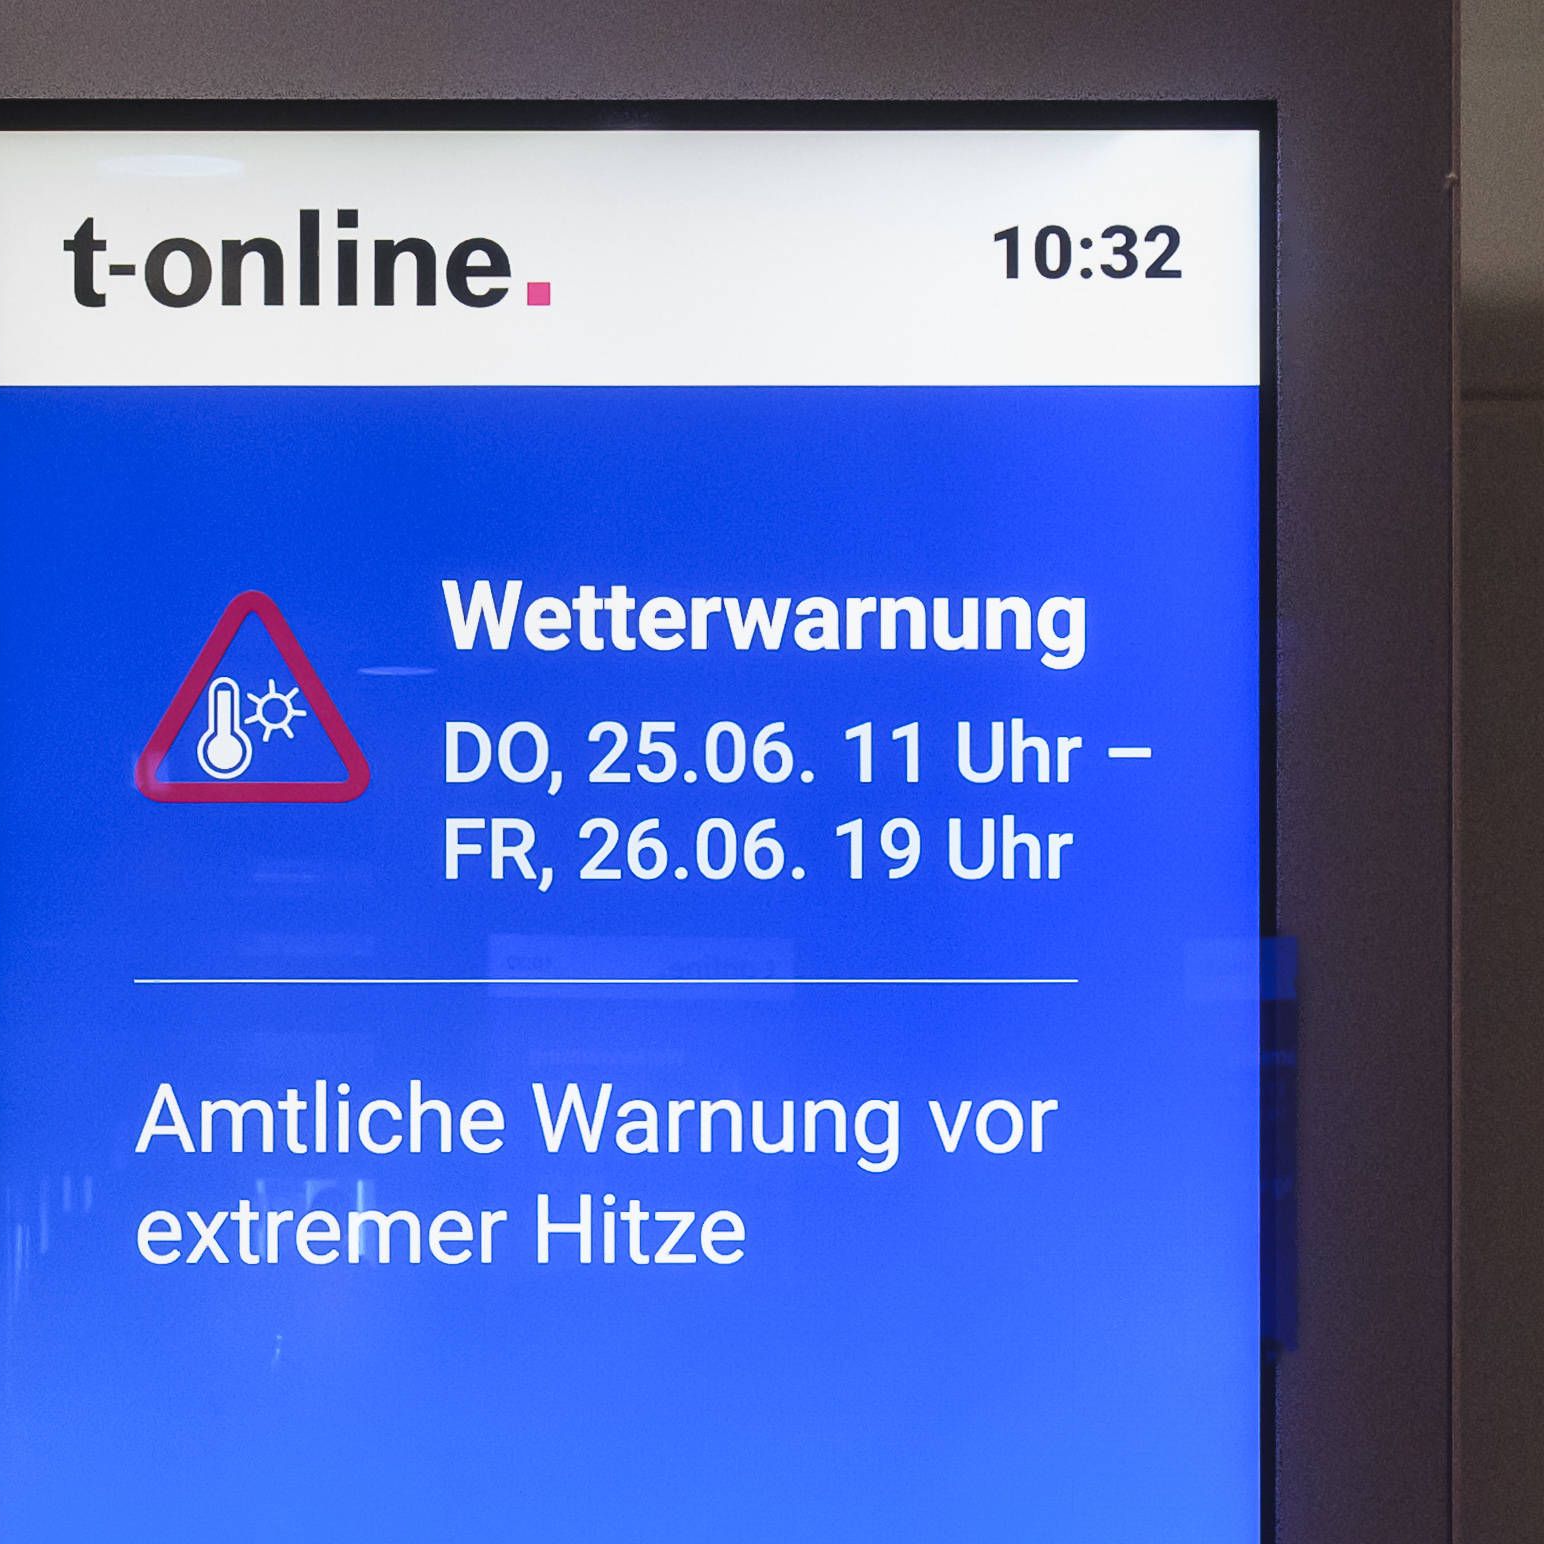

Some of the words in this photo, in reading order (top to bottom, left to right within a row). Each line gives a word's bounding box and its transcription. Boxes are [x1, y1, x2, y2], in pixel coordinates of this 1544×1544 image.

[63, 208, 551, 309] t-online.
[993, 224, 1182, 280] 10:32
[441, 579, 1086, 670] Wetterwarnung
[445, 721, 563, 796] DO,
[588, 721, 814, 783] 25.06.
[845, 721, 919, 783] 11
[958, 718, 1083, 783] Uhr
[445, 817, 553, 892] FR,
[579, 817, 805, 880] 26.06.
[836, 817, 921, 880] 19
[949, 814, 1074, 880] Uhr
[135, 1079, 505, 1154] Amtliche
[532, 1082, 899, 1173] Warnung
[928, 1099, 1059, 1154] vor
[137, 1199, 508, 1265] extremer
[537, 1193, 746, 1265] Hitze
